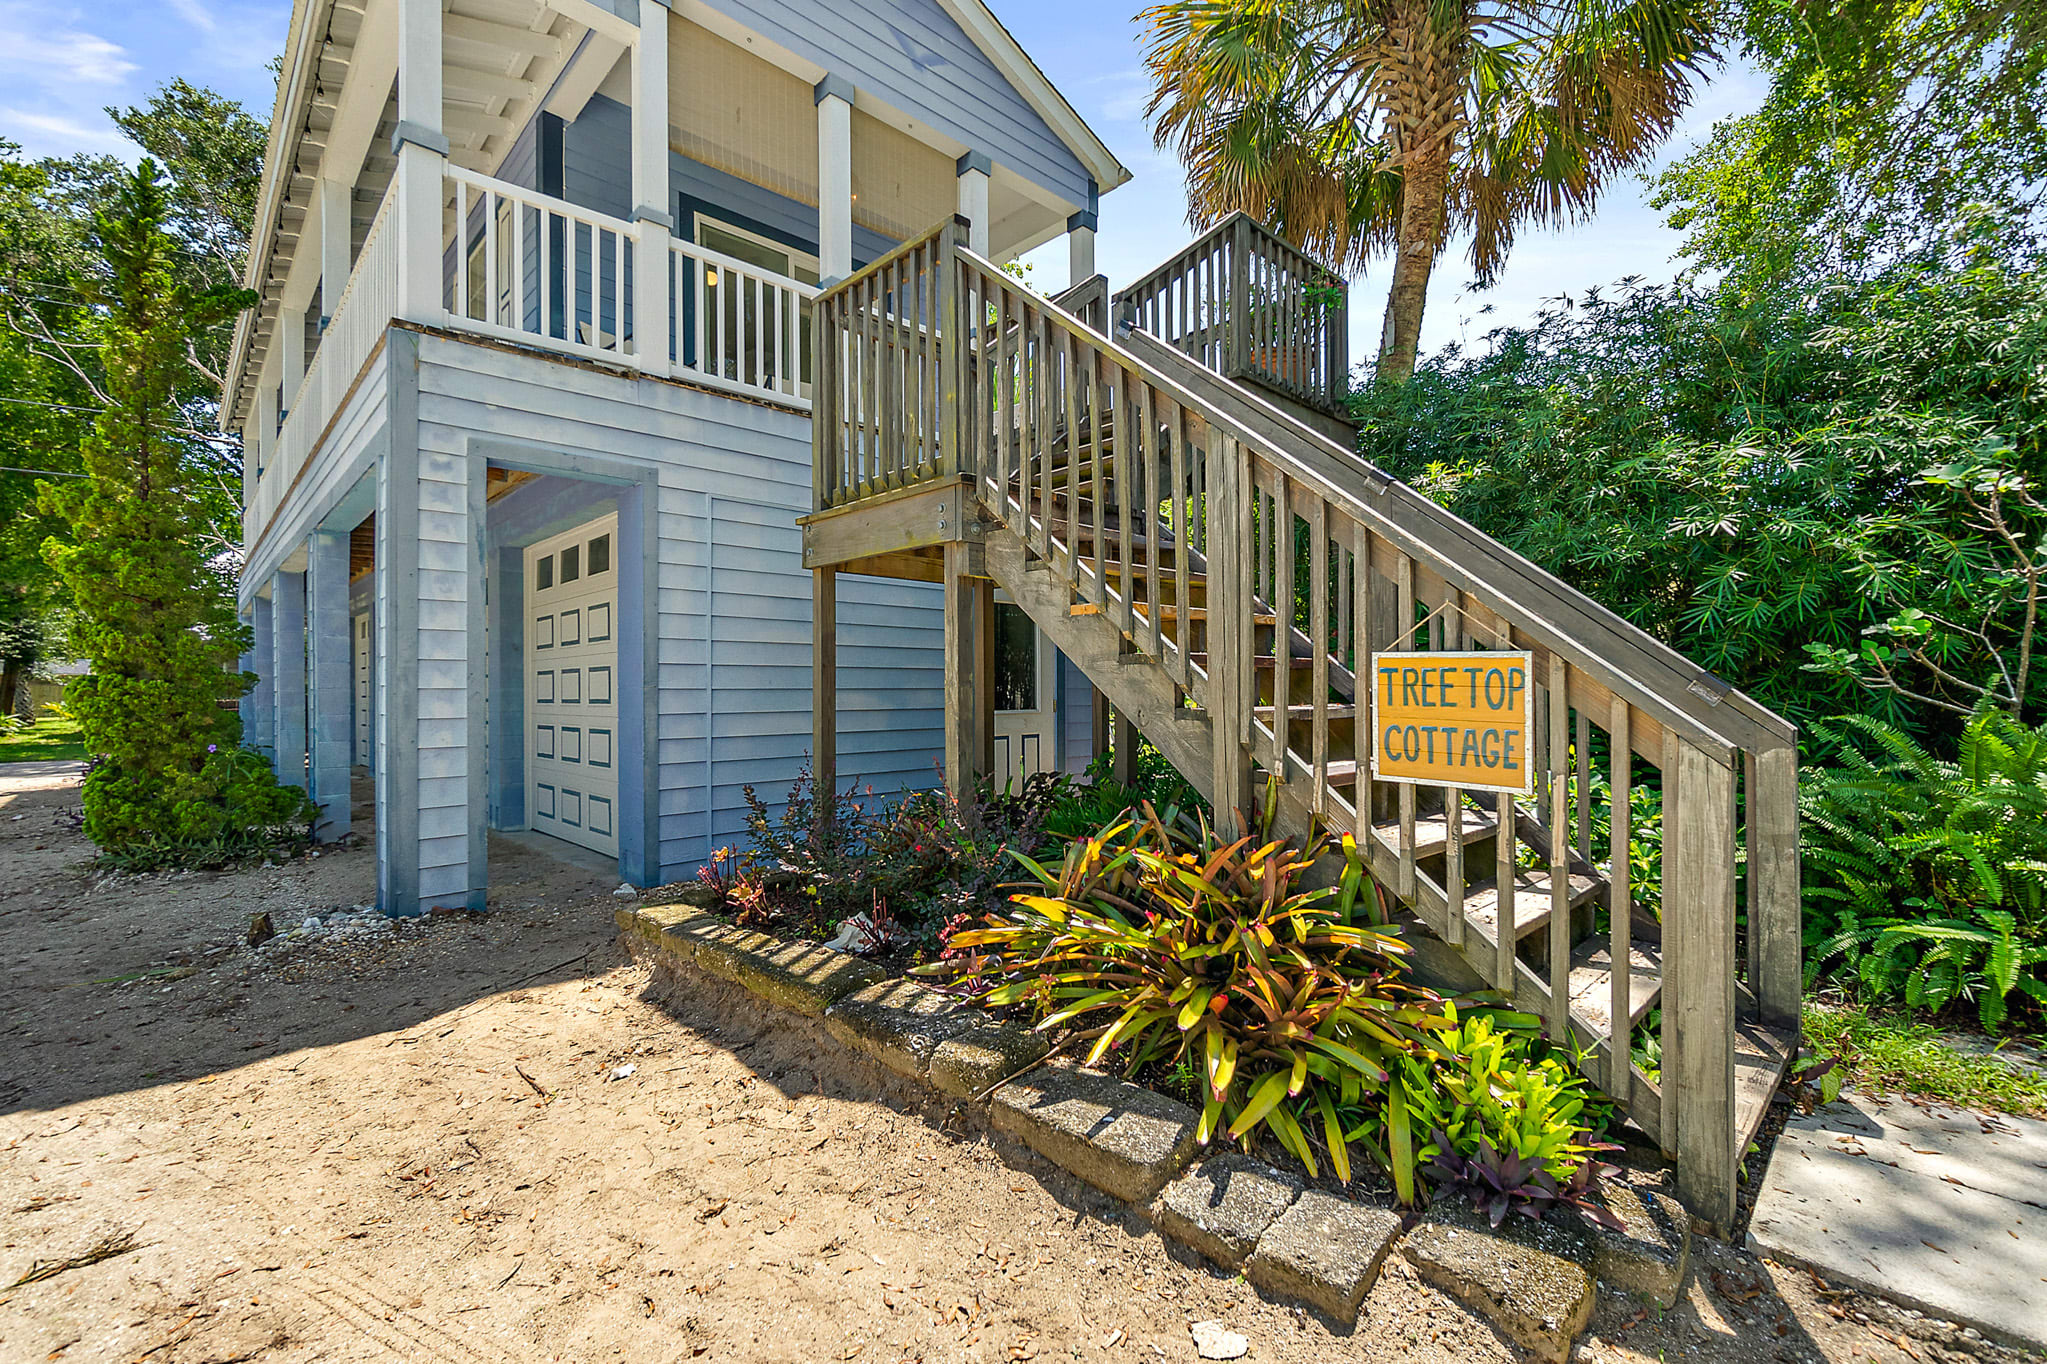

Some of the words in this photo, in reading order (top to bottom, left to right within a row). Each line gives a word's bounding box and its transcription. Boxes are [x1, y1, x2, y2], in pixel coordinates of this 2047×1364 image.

[1379, 667, 1458, 707] TREE
[1463, 667, 1525, 711] TOP
[1384, 724, 1519, 770] COTTAGE
